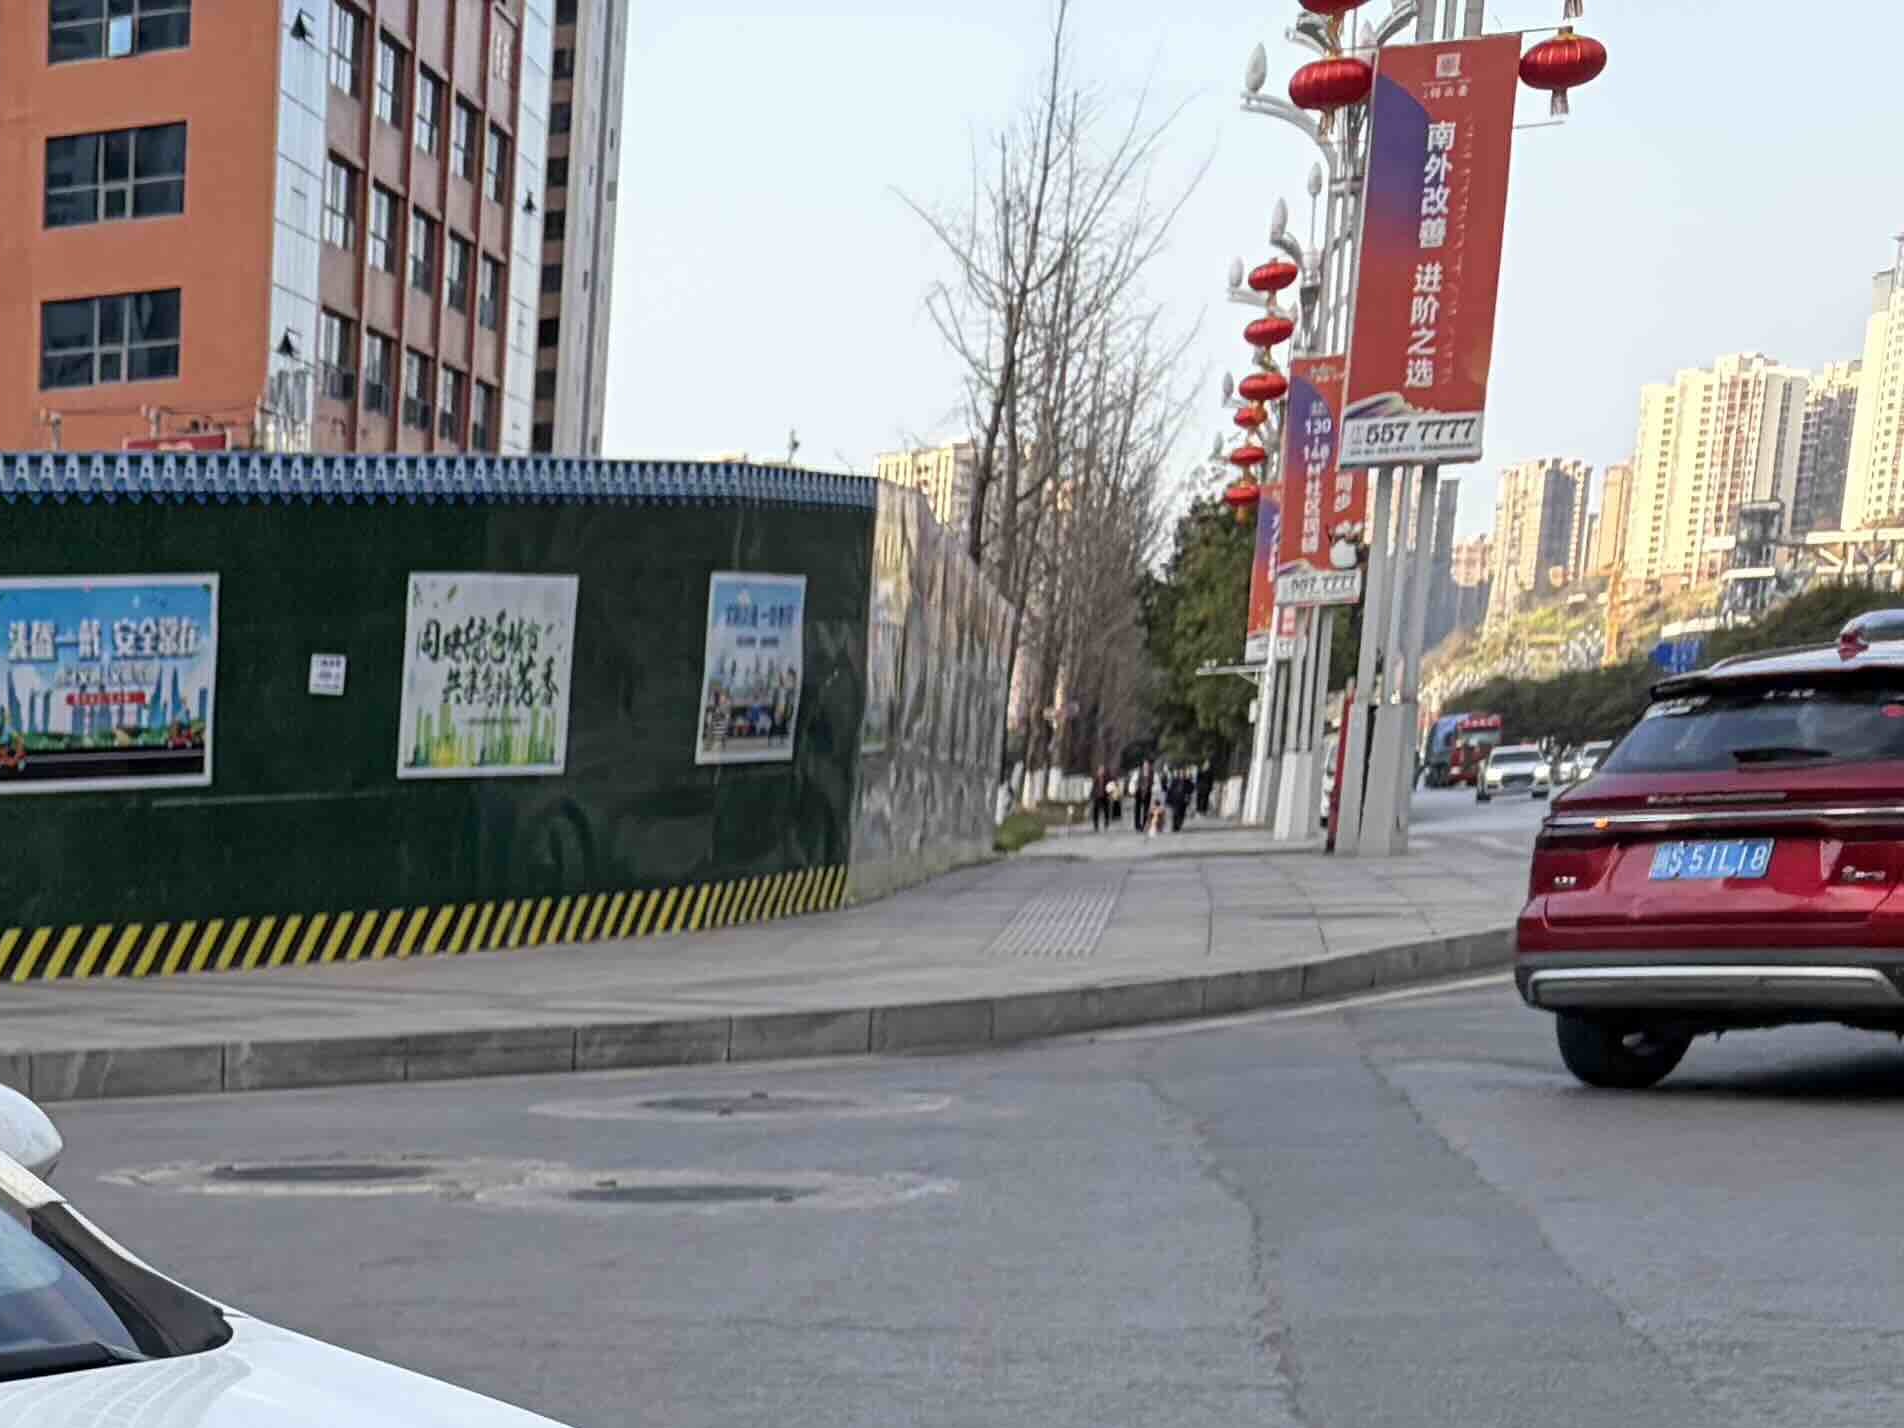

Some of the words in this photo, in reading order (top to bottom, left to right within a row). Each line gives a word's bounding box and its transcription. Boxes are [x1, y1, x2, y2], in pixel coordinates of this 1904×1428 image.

[1419, 121, 1457, 248] 南外改善
[1404, 263, 1443, 388] 进阶之选
[1365, 421, 1411, 446] 557
[1417, 418, 1476, 441] 7777
